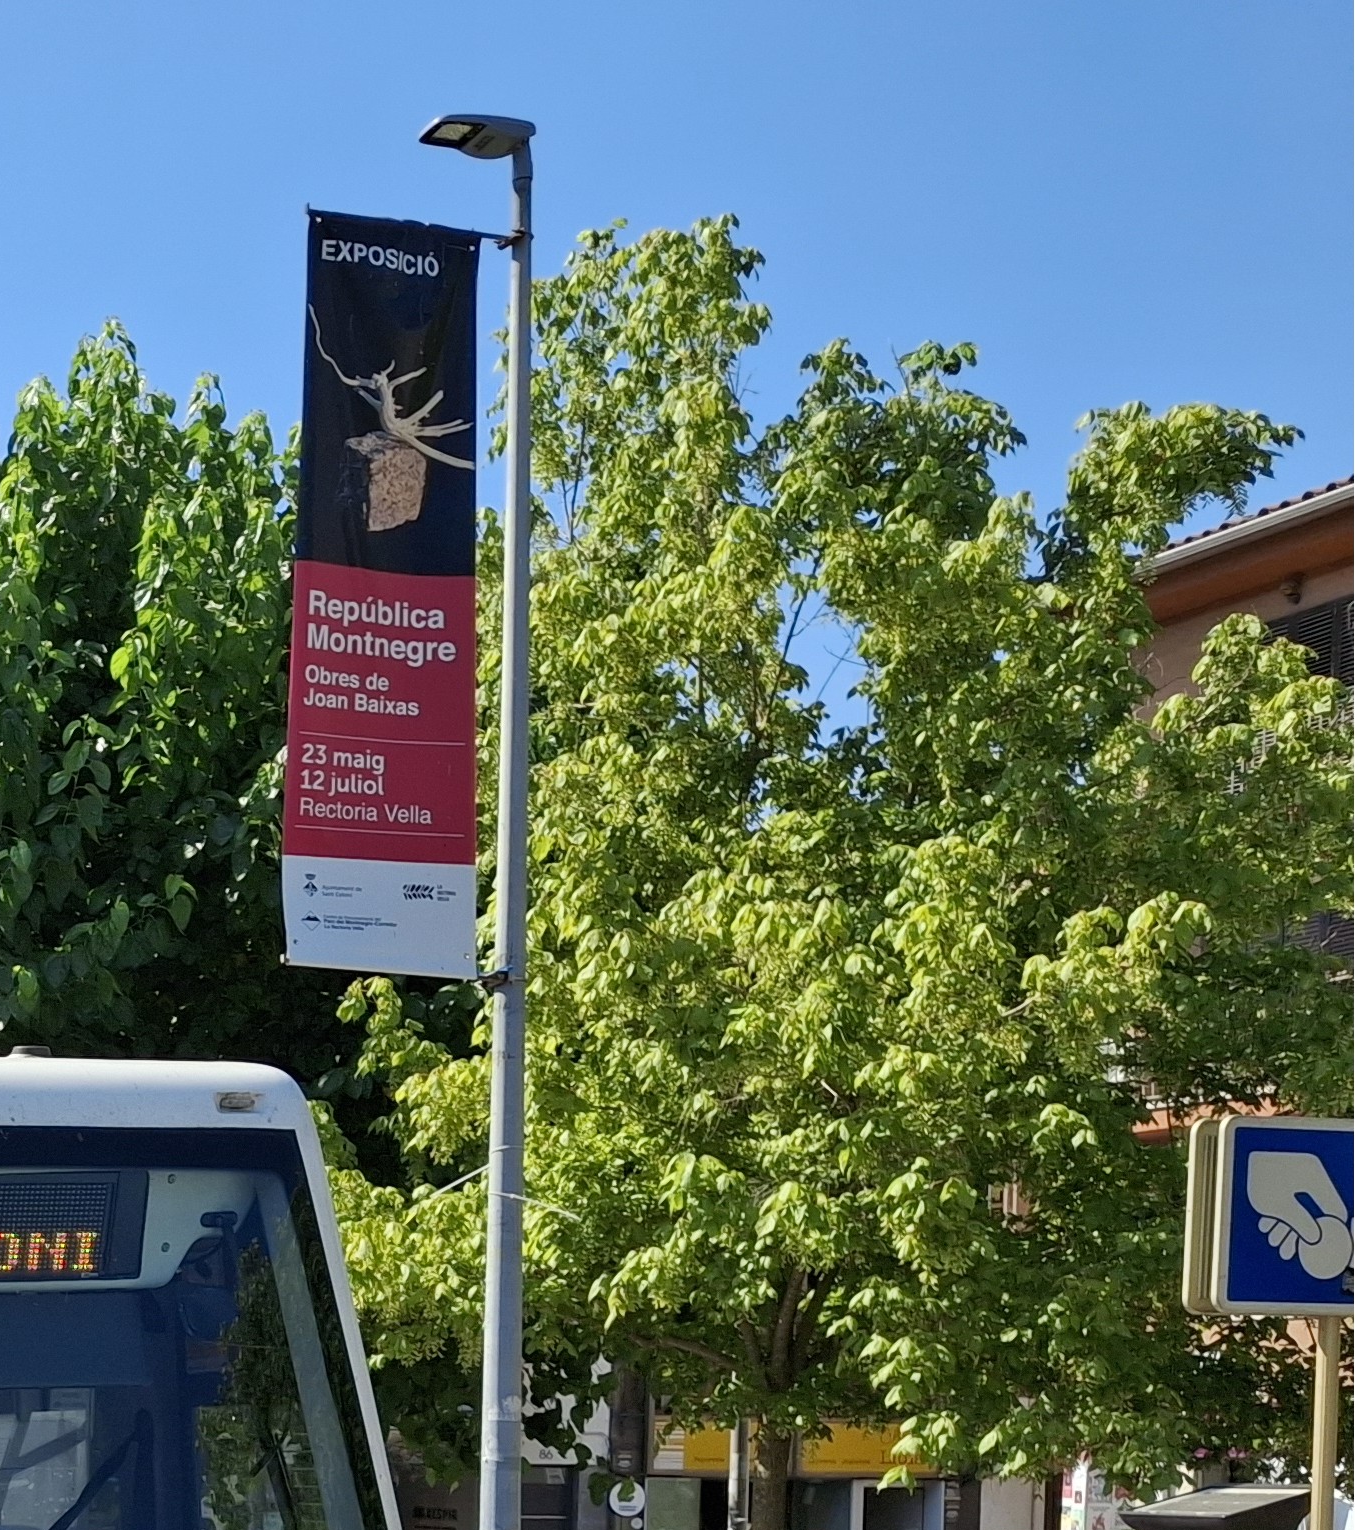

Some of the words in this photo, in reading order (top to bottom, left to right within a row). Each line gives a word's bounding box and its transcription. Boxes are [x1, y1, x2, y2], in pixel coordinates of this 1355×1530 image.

[320, 238, 440, 278] EXPOSICIÓ
[308, 589, 445, 629] República
[306, 622, 457, 667] Montnegre
[304, 664, 360, 689] Obres
[365, 672, 390, 691] de
[303, 689, 348, 709] Joan
[354, 693, 420, 716] Baixas
[301, 743, 327, 764] 23
[333, 750, 385, 775] maig
[300, 769, 325, 791] 12
[328, 773, 385, 796] juliol
[299, 797, 378, 822] Rectoria
[384, 804, 432, 824] Vella
[539, 1450, 554, 1460] 86
